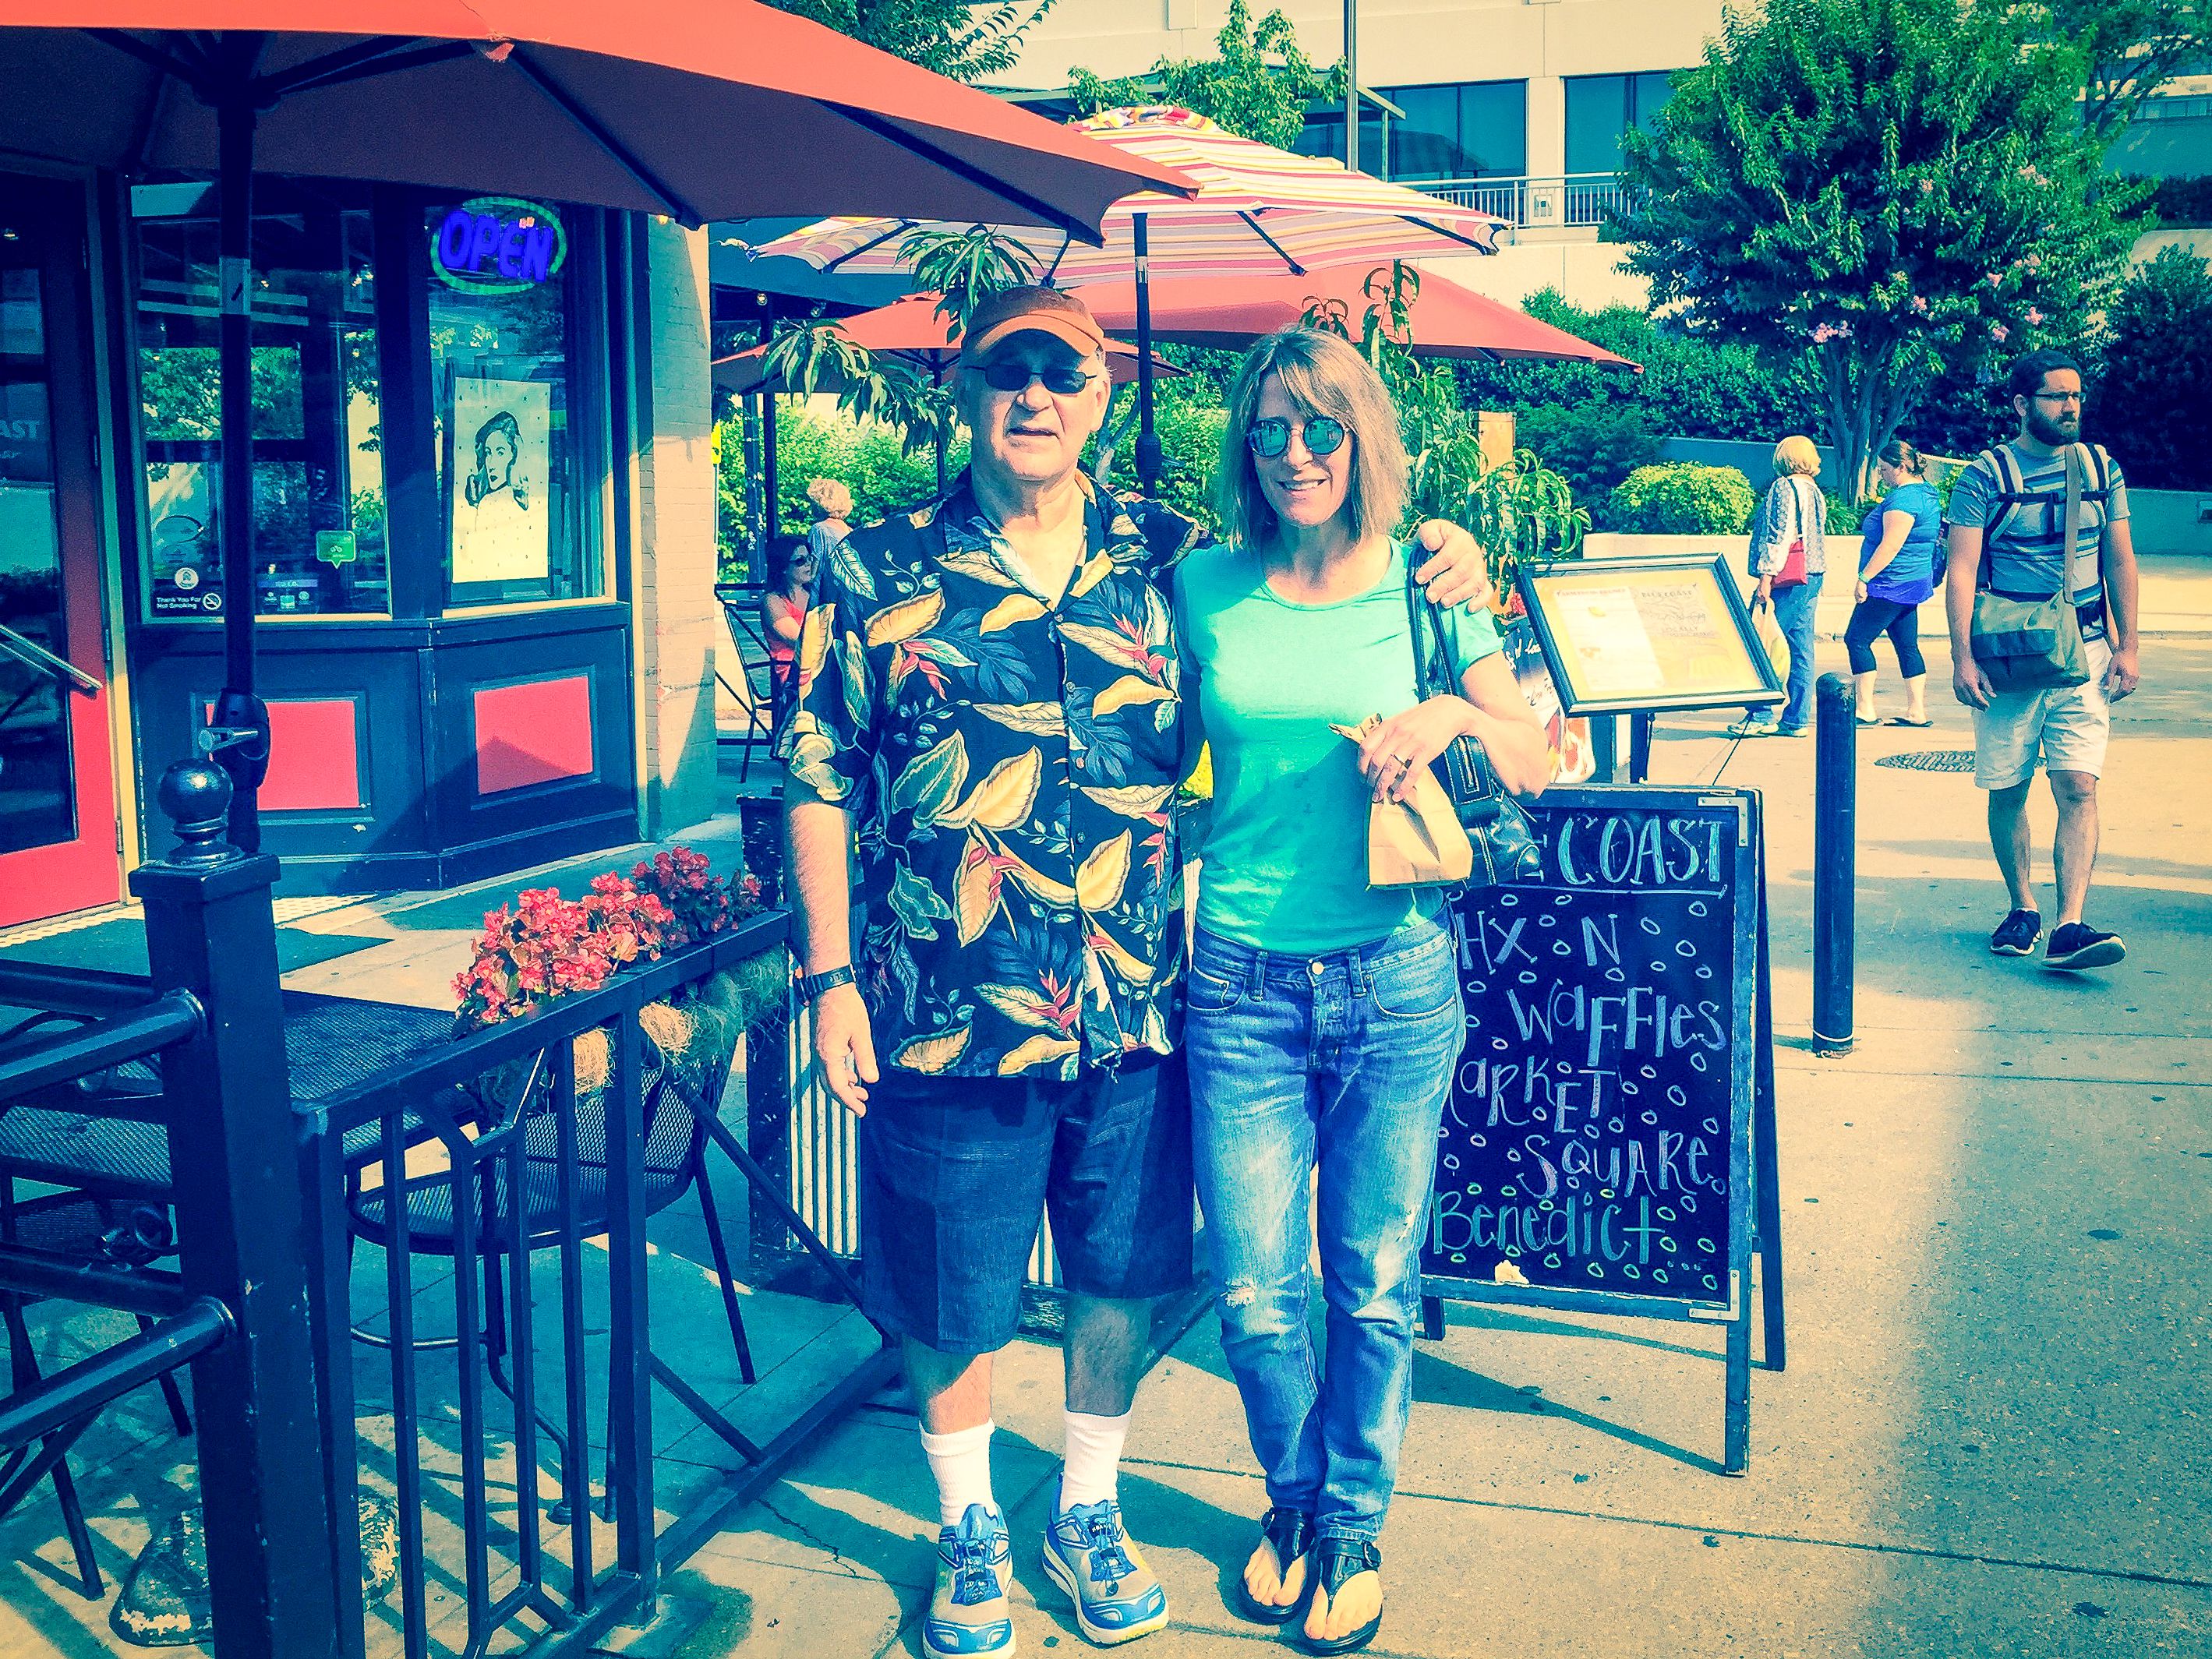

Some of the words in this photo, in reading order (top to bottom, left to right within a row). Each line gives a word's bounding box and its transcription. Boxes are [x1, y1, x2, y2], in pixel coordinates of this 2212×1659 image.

[440, 209, 554, 283] OPEN
[1559, 815, 1723, 884] COAST
[1581, 912, 1620, 966] N
[1433, 1189, 1666, 1265] Benedict
